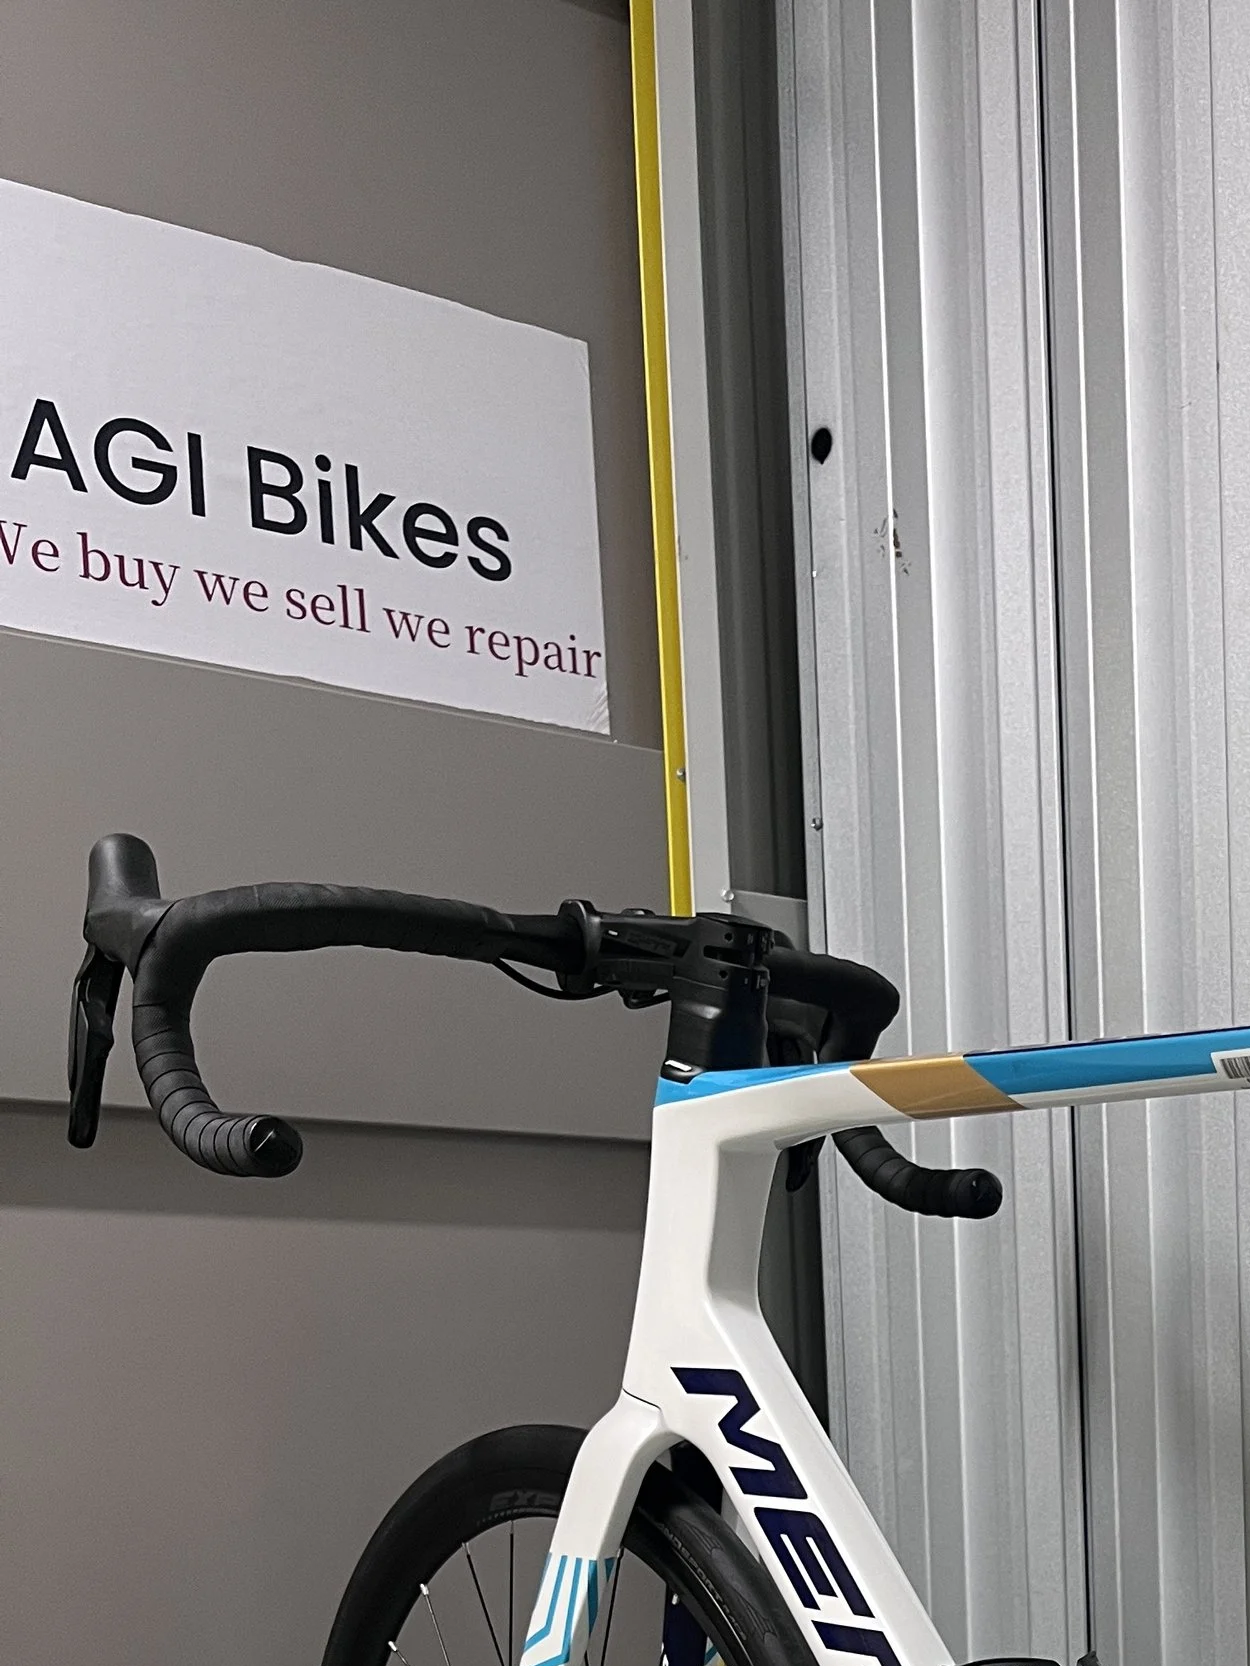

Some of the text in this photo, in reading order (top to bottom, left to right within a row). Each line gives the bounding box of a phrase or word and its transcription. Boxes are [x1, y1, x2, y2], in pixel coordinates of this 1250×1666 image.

[11, 399, 512, 582] AGI Bikes
[79, 532, 180, 607] buy
[196, 568, 269, 612] we
[285, 584, 371, 633] sell
[383, 608, 451, 648] we
[465, 622, 602, 678] repair
